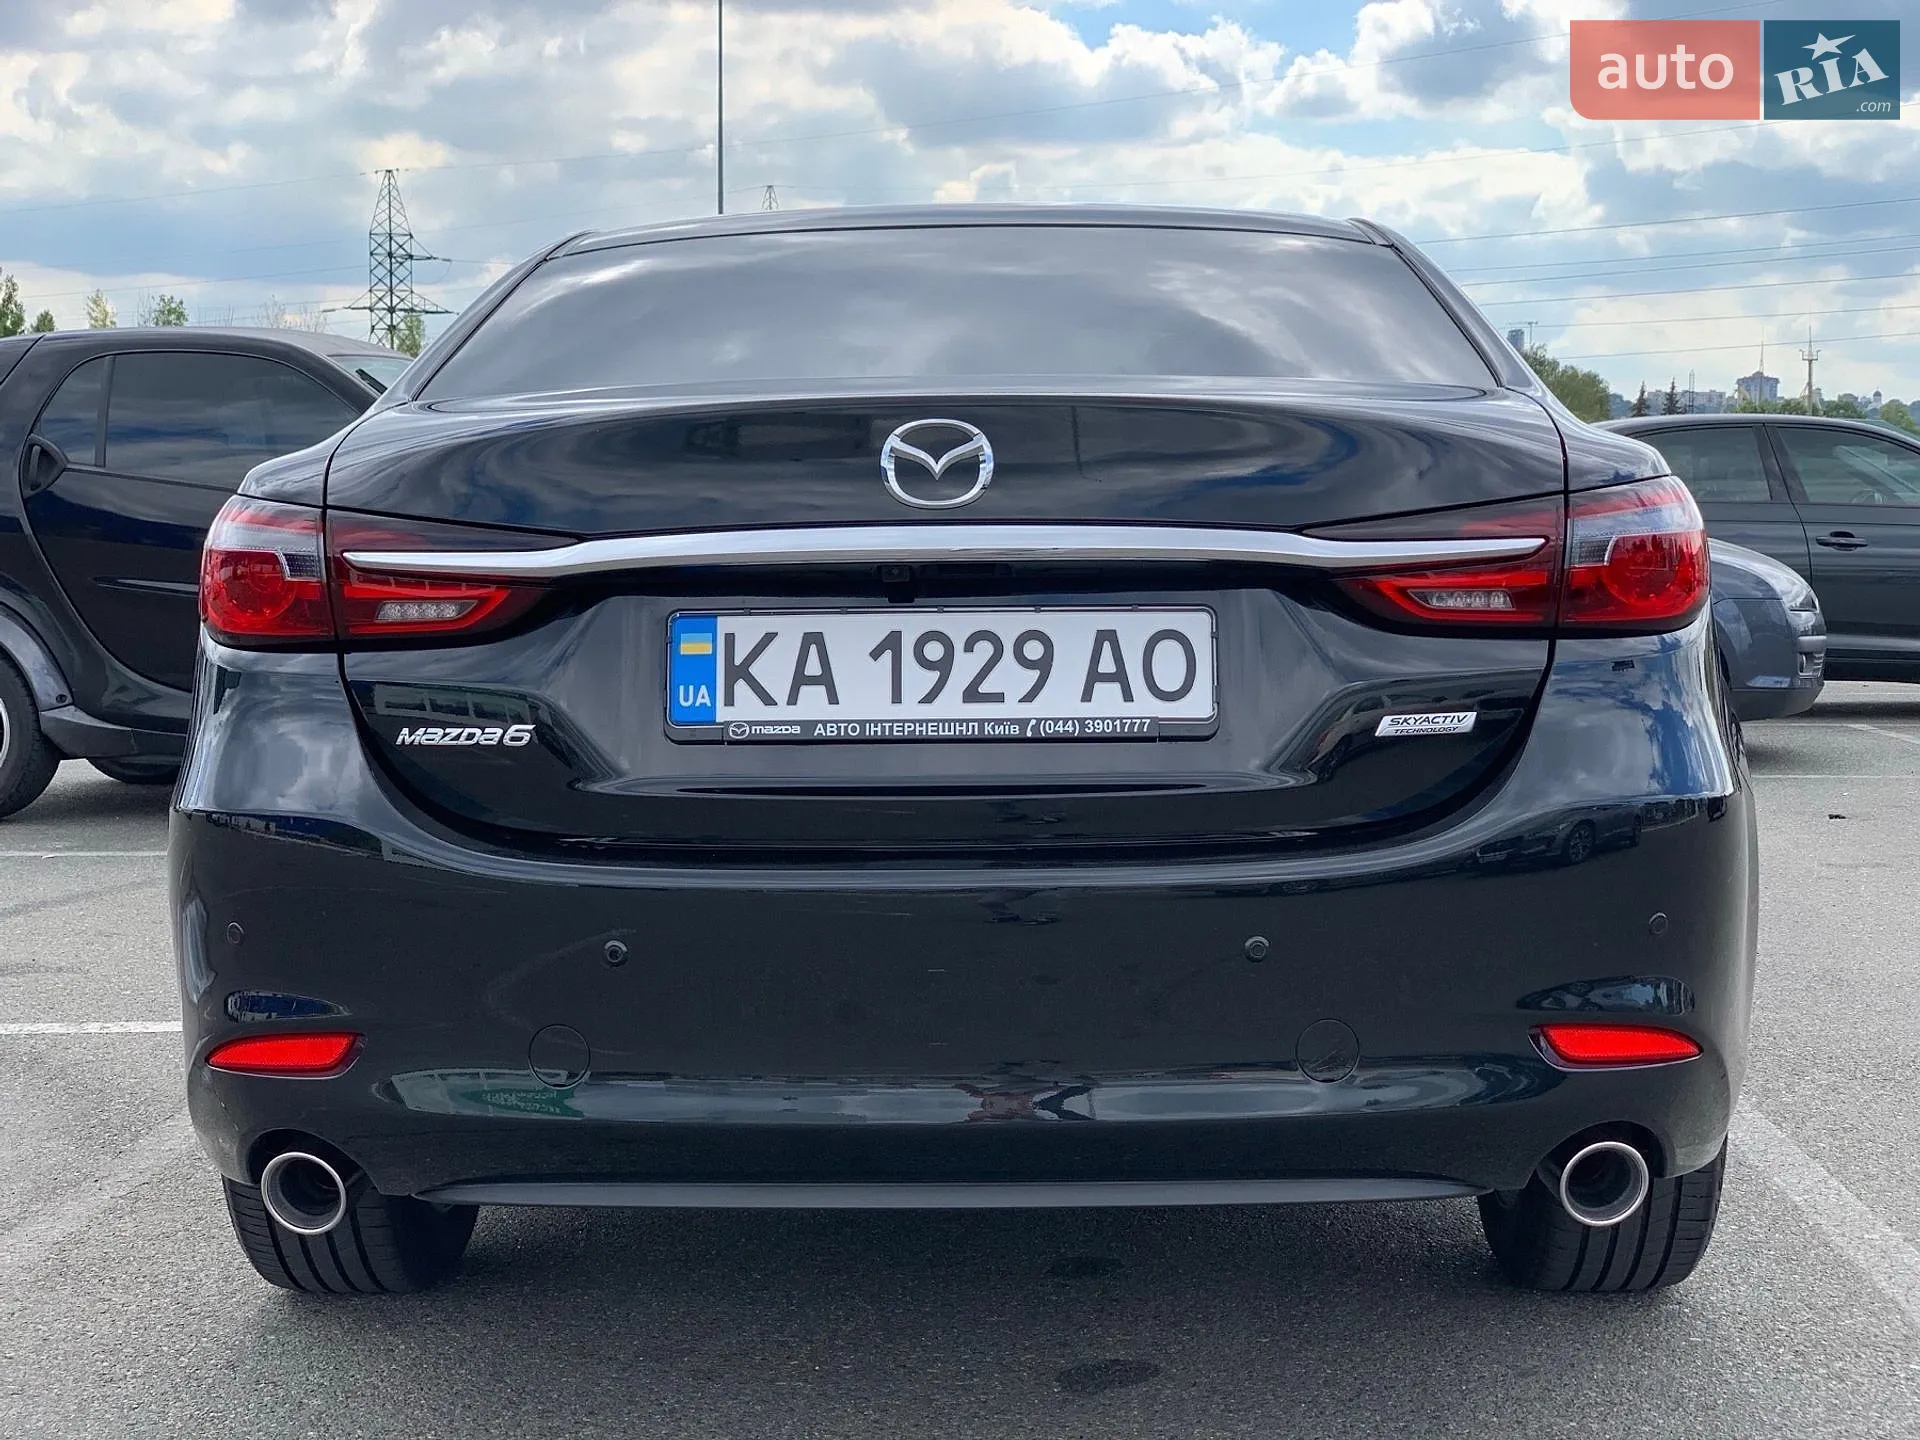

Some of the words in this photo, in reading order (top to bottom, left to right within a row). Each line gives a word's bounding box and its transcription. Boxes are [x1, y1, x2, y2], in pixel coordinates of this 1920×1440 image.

[723, 631, 840, 707] KA
[868, 629, 1055, 705] 1929
[1081, 628, 1197, 703] AO
[679, 685, 711, 707] UA
[814, 723, 857, 737] АВТО
[866, 722, 979, 737] ІНТЕРНЕШНЛ
[984, 722, 1020, 735] Київ
[1039, 720, 1080, 735] (044)
[1084, 719, 1150, 733] 3901777
[1389, 715, 1468, 725] SKYACTIV
